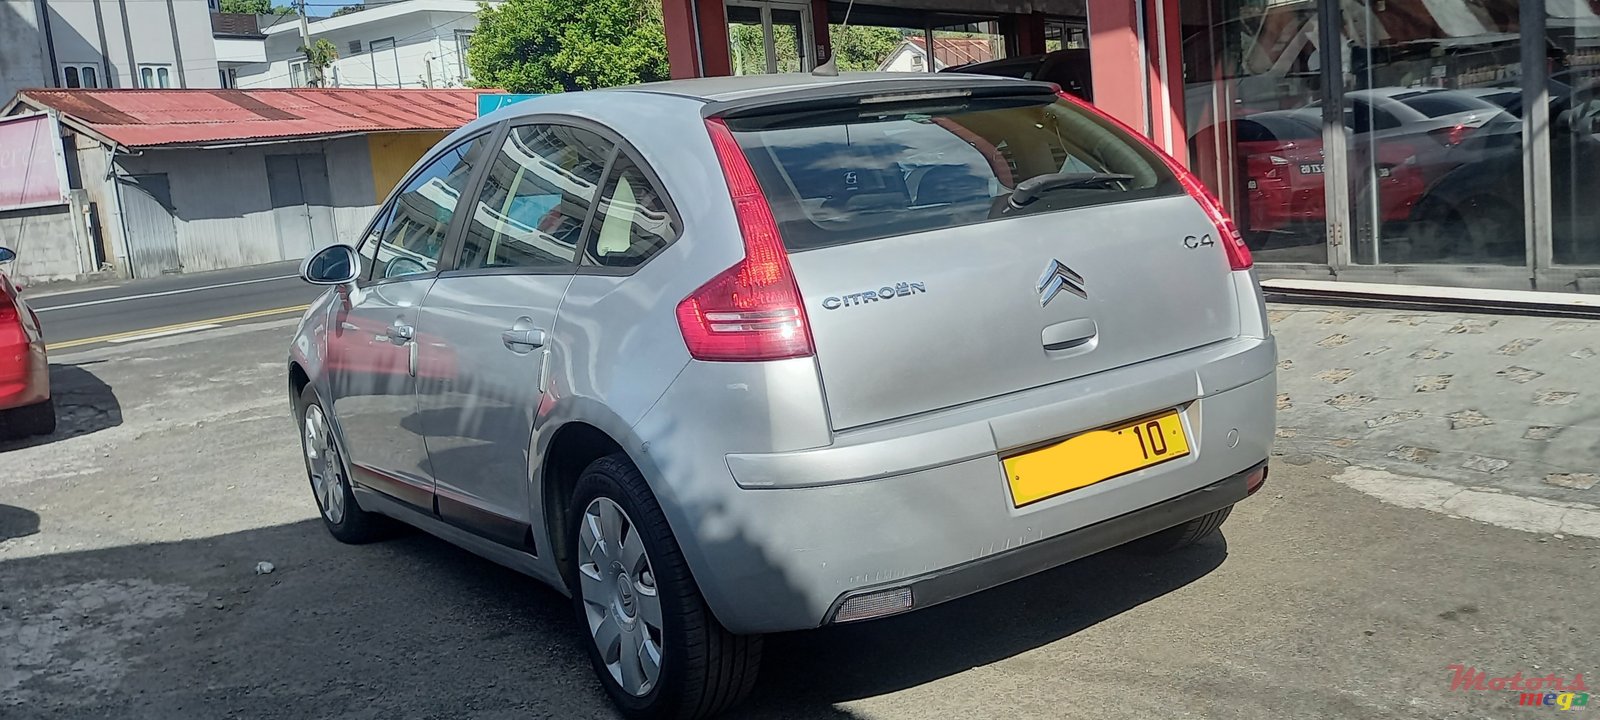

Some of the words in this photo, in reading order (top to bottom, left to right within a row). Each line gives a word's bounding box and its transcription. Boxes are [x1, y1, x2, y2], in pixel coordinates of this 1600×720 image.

[1184, 233, 1214, 249] C4
[822, 281, 926, 310] CITROËN
[1133, 420, 1167, 460] 10
